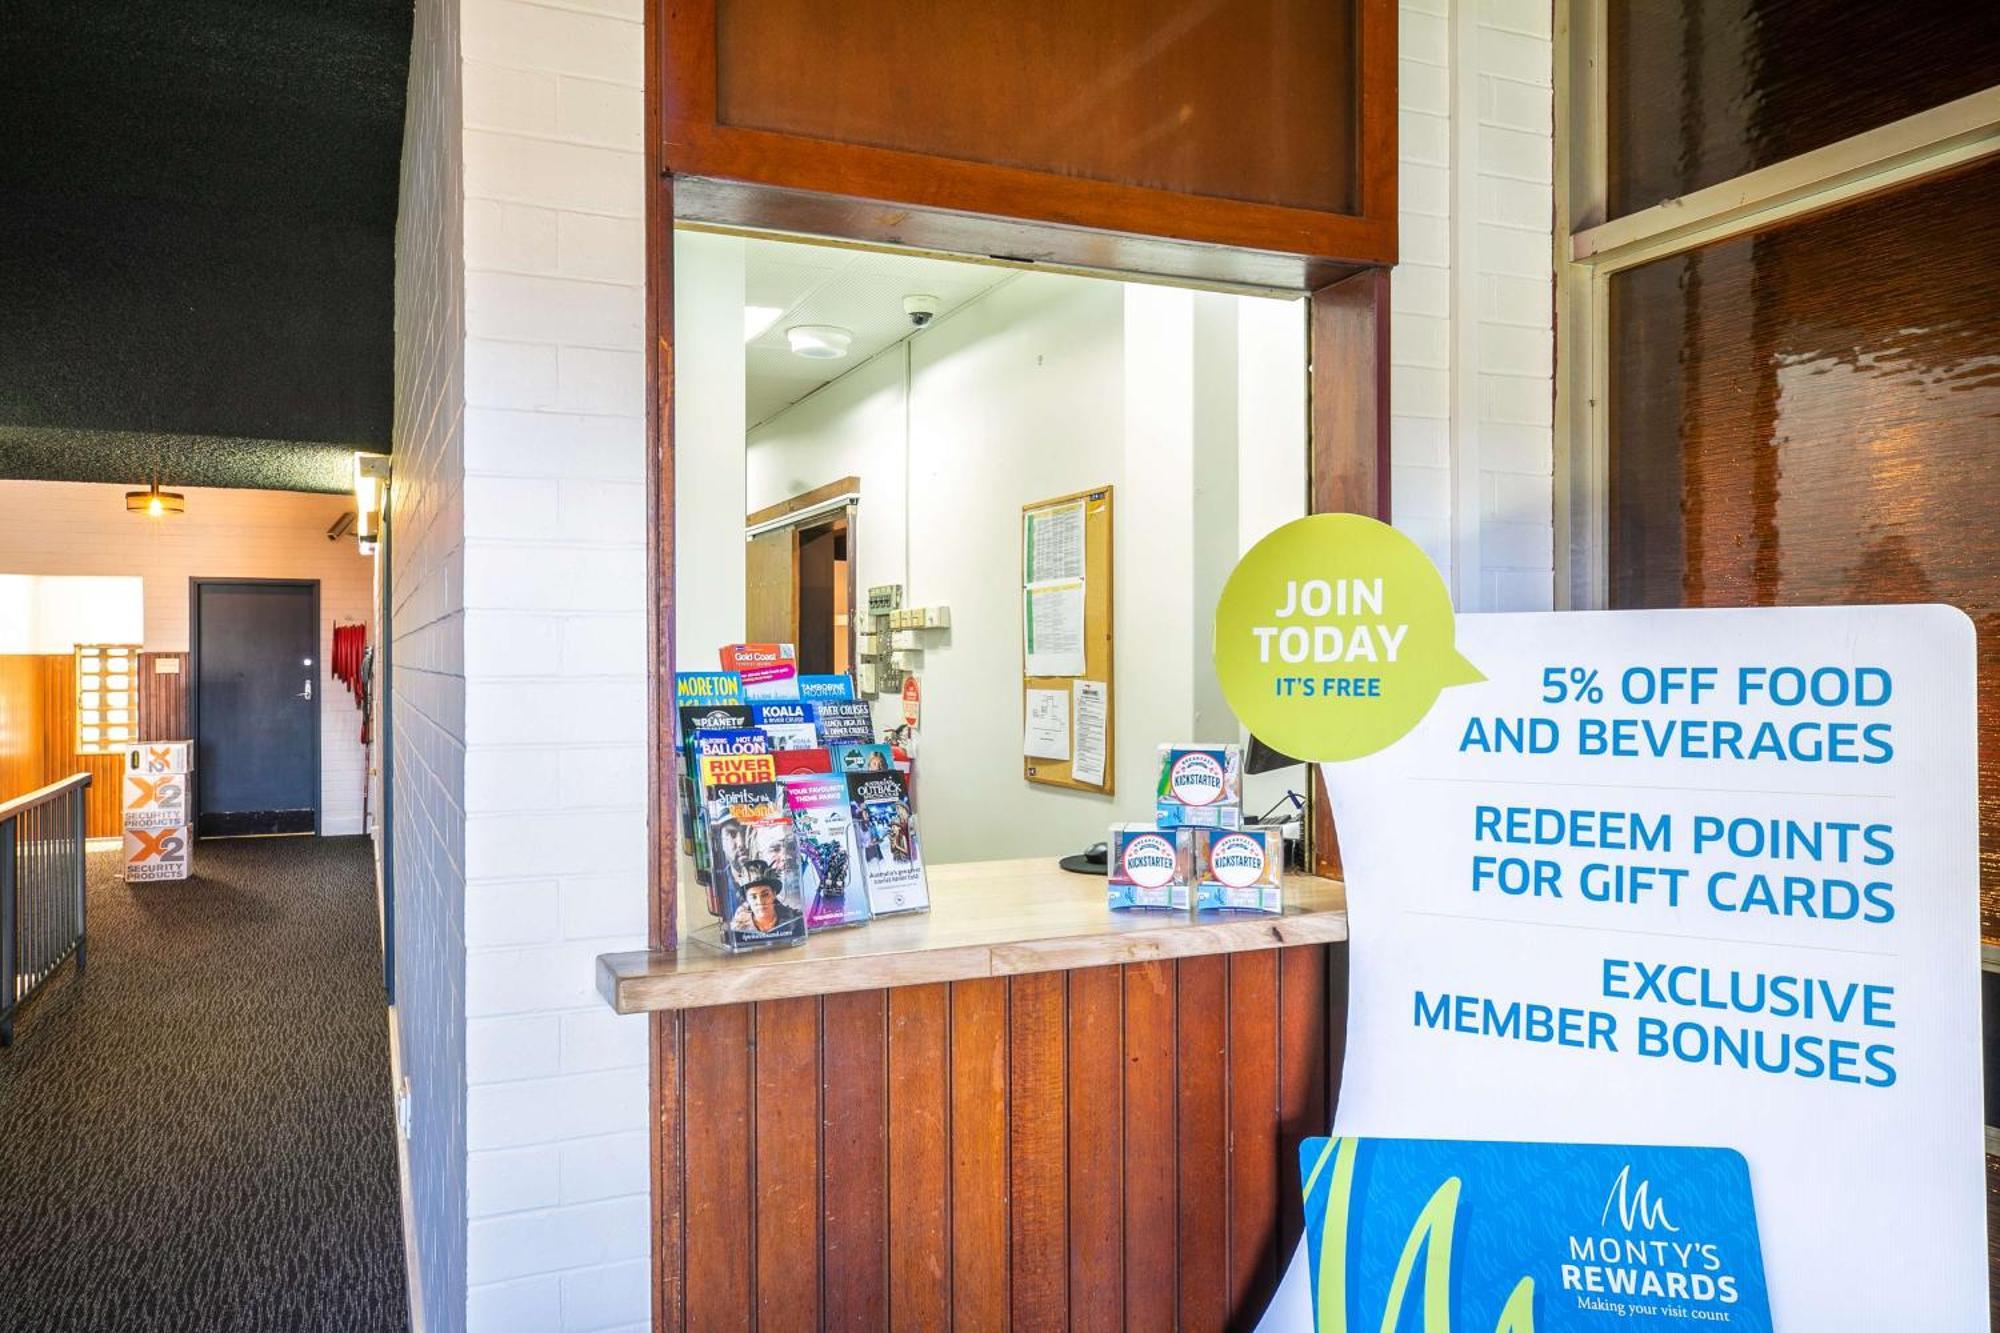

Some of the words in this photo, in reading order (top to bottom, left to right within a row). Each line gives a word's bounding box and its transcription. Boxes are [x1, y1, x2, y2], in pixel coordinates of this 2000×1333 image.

[1276, 579, 1383, 618] JOIN
[1252, 624, 1408, 663] TODAY
[735, 652, 753, 661] Gold
[754, 652, 777, 661] Coast
[678, 676, 739, 697] MORETON
[1276, 678, 1315, 697] IT'S
[1323, 678, 1381, 697] FREE
[1542, 666, 1604, 705] 5%
[1620, 666, 1719, 706] OFF
[1738, 666, 1893, 708] FOOD
[762, 705, 804, 718] KOALA
[701, 717, 738, 728] PLANET
[752, 735, 764, 743] AIR
[1459, 716, 1560, 755] AND
[1578, 718, 1895, 765] BEVERAGES
[703, 742, 766, 755] BALLOON
[710, 759, 771, 772] RIVER
[712, 772, 772, 785] TOUR
[1174, 773, 1221, 789] KICKSTARTER
[127, 775, 182, 809] X2
[718, 788, 755, 806] Spirits
[788, 786, 808, 795] YOUR
[857, 783, 902, 796] OUTBACK
[125, 810, 181, 819] SECURITY
[124, 819, 181, 828] PRODUCTS
[1475, 805, 1672, 853] REDEEM
[1693, 815, 1895, 866] POINTS
[129, 826, 185, 863] X2
[127, 863, 184, 873] SECURITY
[1127, 855, 1174, 870] KICKSTARTER
[1214, 855, 1262, 870] KICKSTARTER
[126, 871, 184, 881] PRODUCTS
[1471, 855, 1563, 898] FOR
[1579, 862, 1689, 908] GIFT
[1706, 871, 1896, 924] CARDS
[1602, 959, 1896, 1029] EXCLUSIVE
[1413, 990, 1619, 1053] MEMBER
[1636, 1016, 1898, 1089] BONUSES
[1569, 1236, 1720, 1270] MONTY'S
[1561, 1264, 1738, 1303] REWARDS
[1577, 1296, 1626, 1316] Making
[1628, 1303, 1658, 1319] your
[1660, 1303, 1688, 1318] visit
[1691, 1307, 1730, 1322] count
